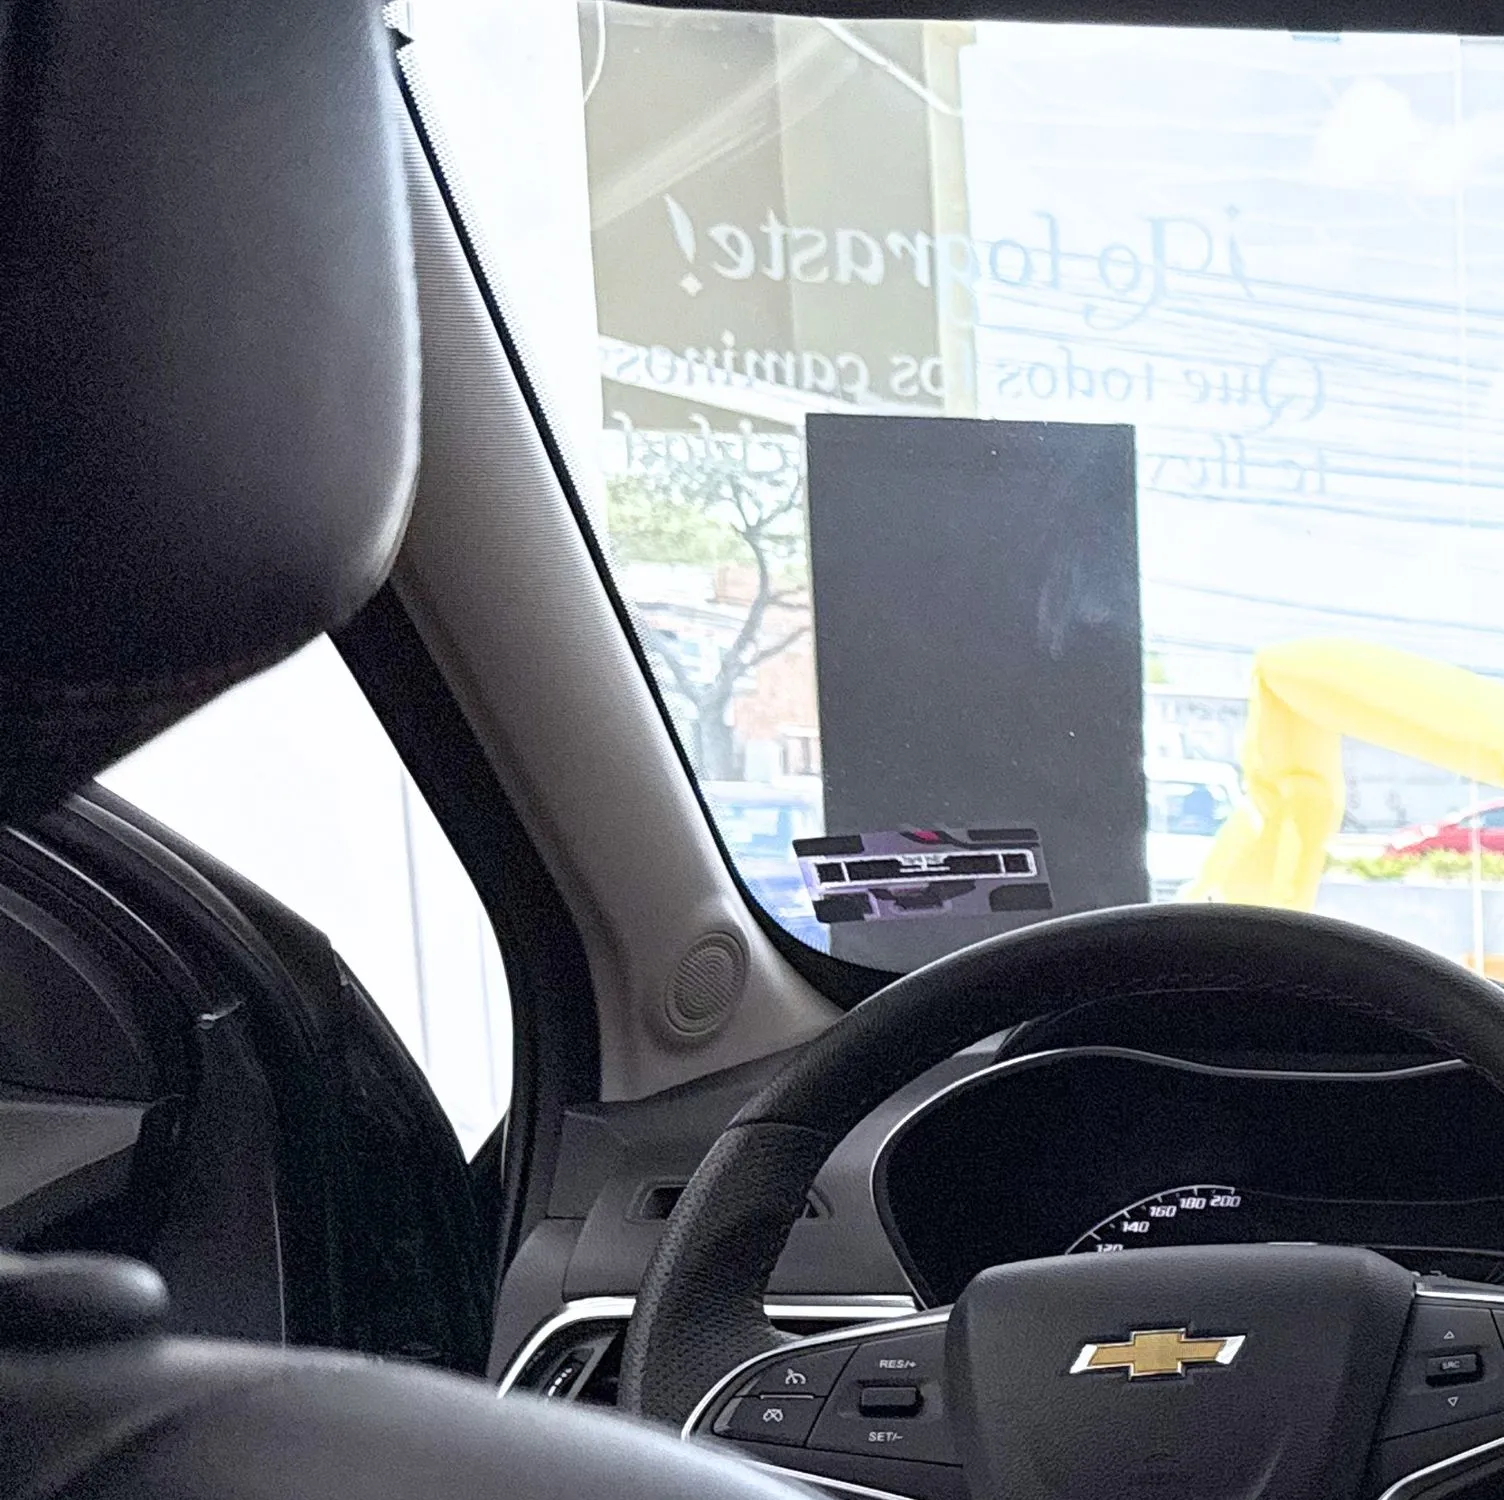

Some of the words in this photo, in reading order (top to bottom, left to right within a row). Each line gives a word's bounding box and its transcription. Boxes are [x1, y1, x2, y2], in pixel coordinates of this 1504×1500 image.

[1179, 1197, 1207, 1209] 180
[1209, 1195, 1242, 1208] 200
[1150, 1205, 1177, 1217] 160
[1122, 1221, 1150, 1233] 140
[879, 1359, 917, 1369] RES/+
